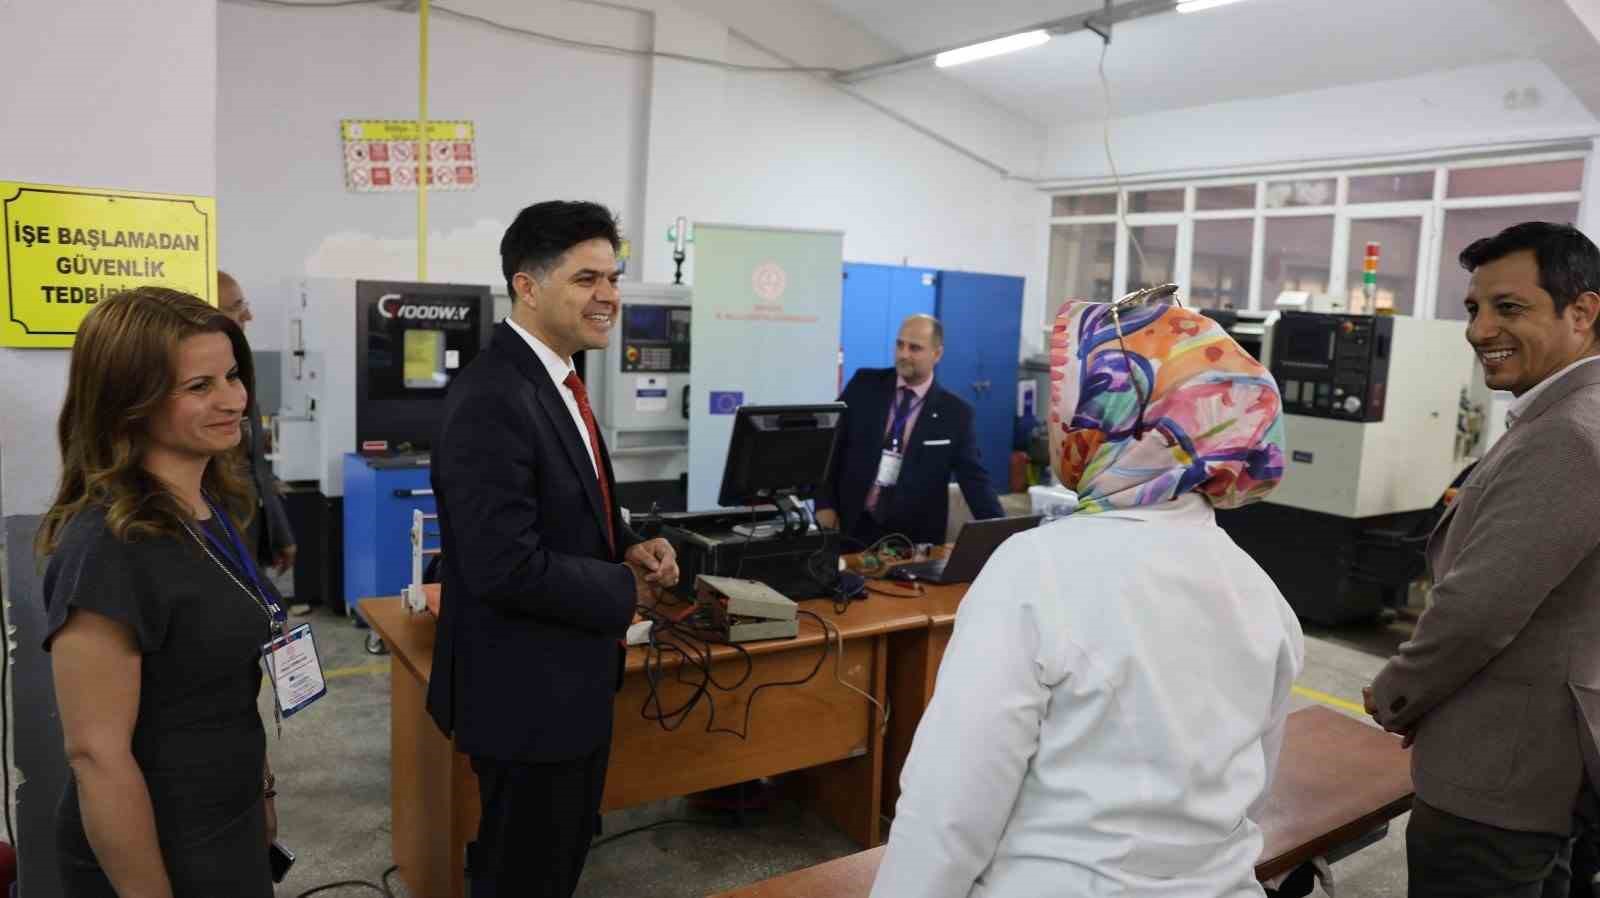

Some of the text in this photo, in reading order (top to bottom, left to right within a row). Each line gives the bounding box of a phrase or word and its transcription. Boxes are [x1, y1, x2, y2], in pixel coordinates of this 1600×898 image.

[14, 220, 200, 251] İŞE BAŞLAMADAN
[56, 254, 165, 278] GÜVENLİK
